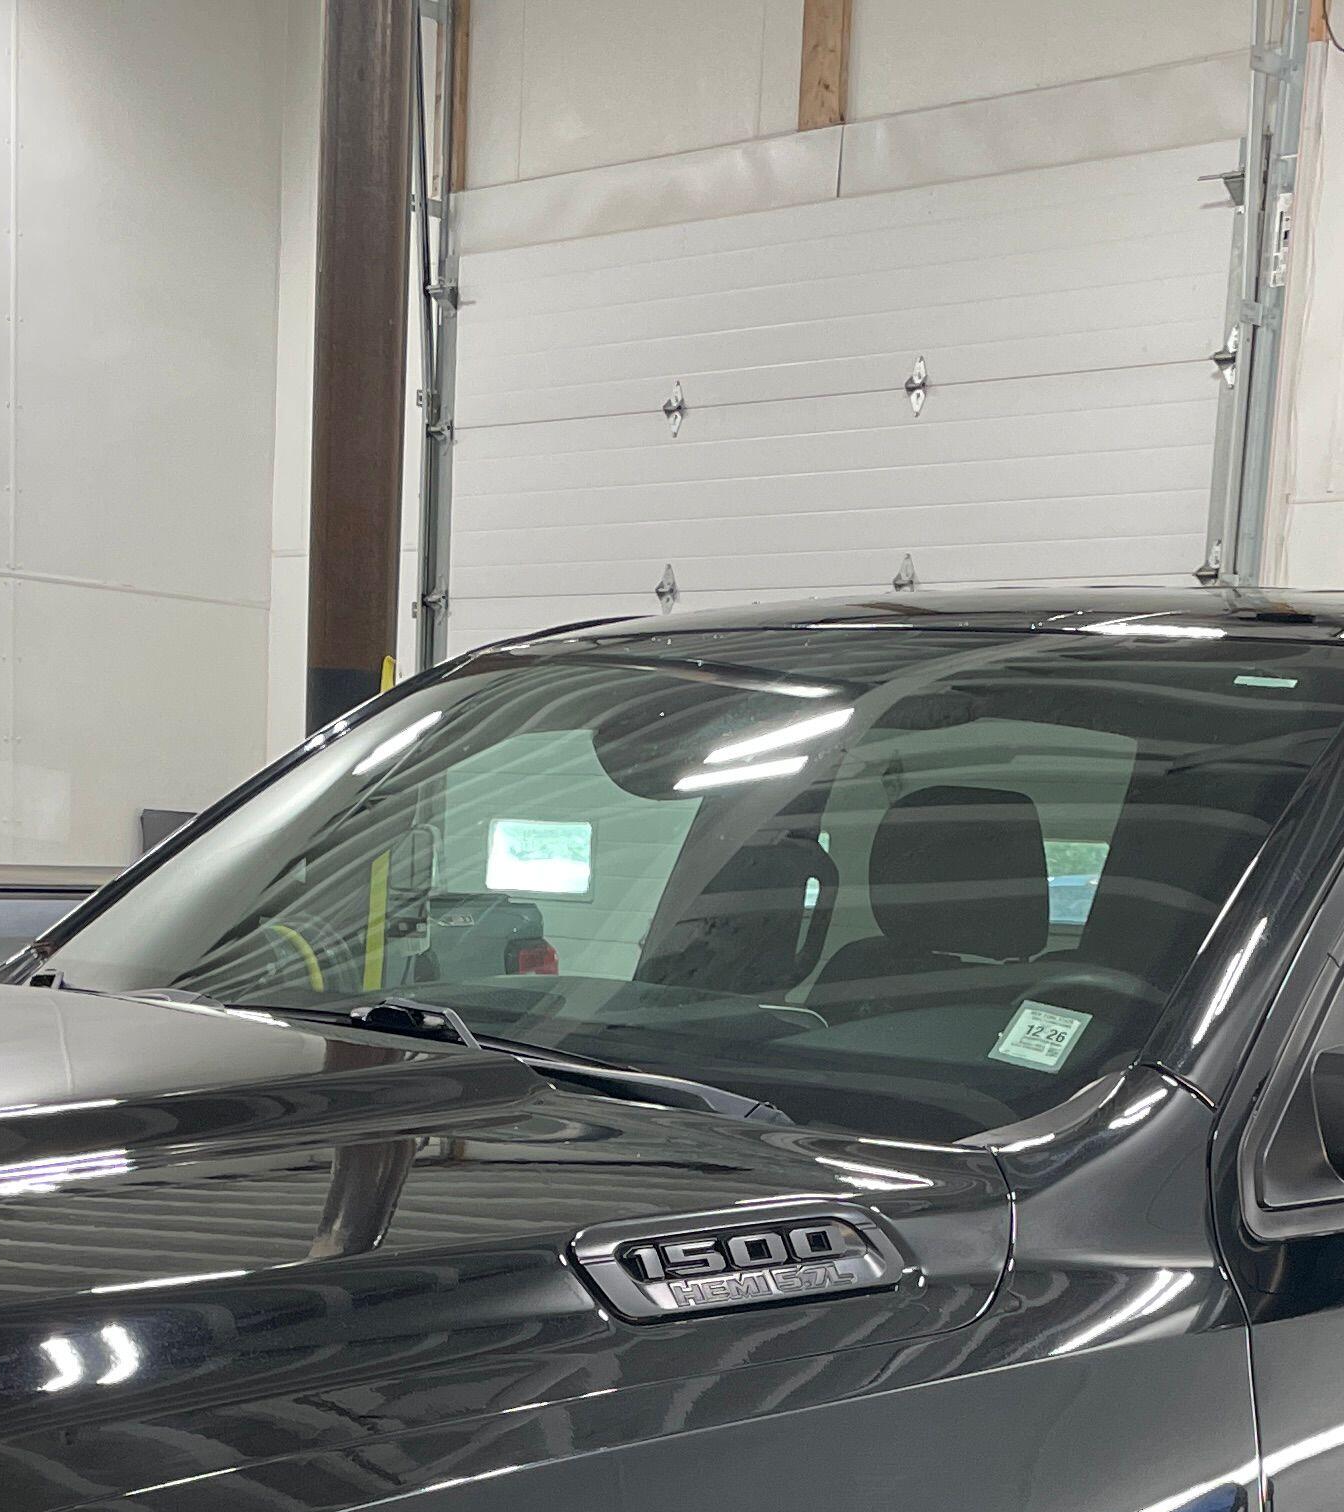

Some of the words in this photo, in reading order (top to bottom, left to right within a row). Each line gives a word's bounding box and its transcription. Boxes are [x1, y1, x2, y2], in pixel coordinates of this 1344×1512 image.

[1025, 1023, 1045, 1038] 12
[1046, 1028, 1068, 1043] 26
[624, 1223, 847, 1280] 1500
[670, 1271, 771, 1308] HEMI
[774, 1261, 855, 1293] 5.7L
